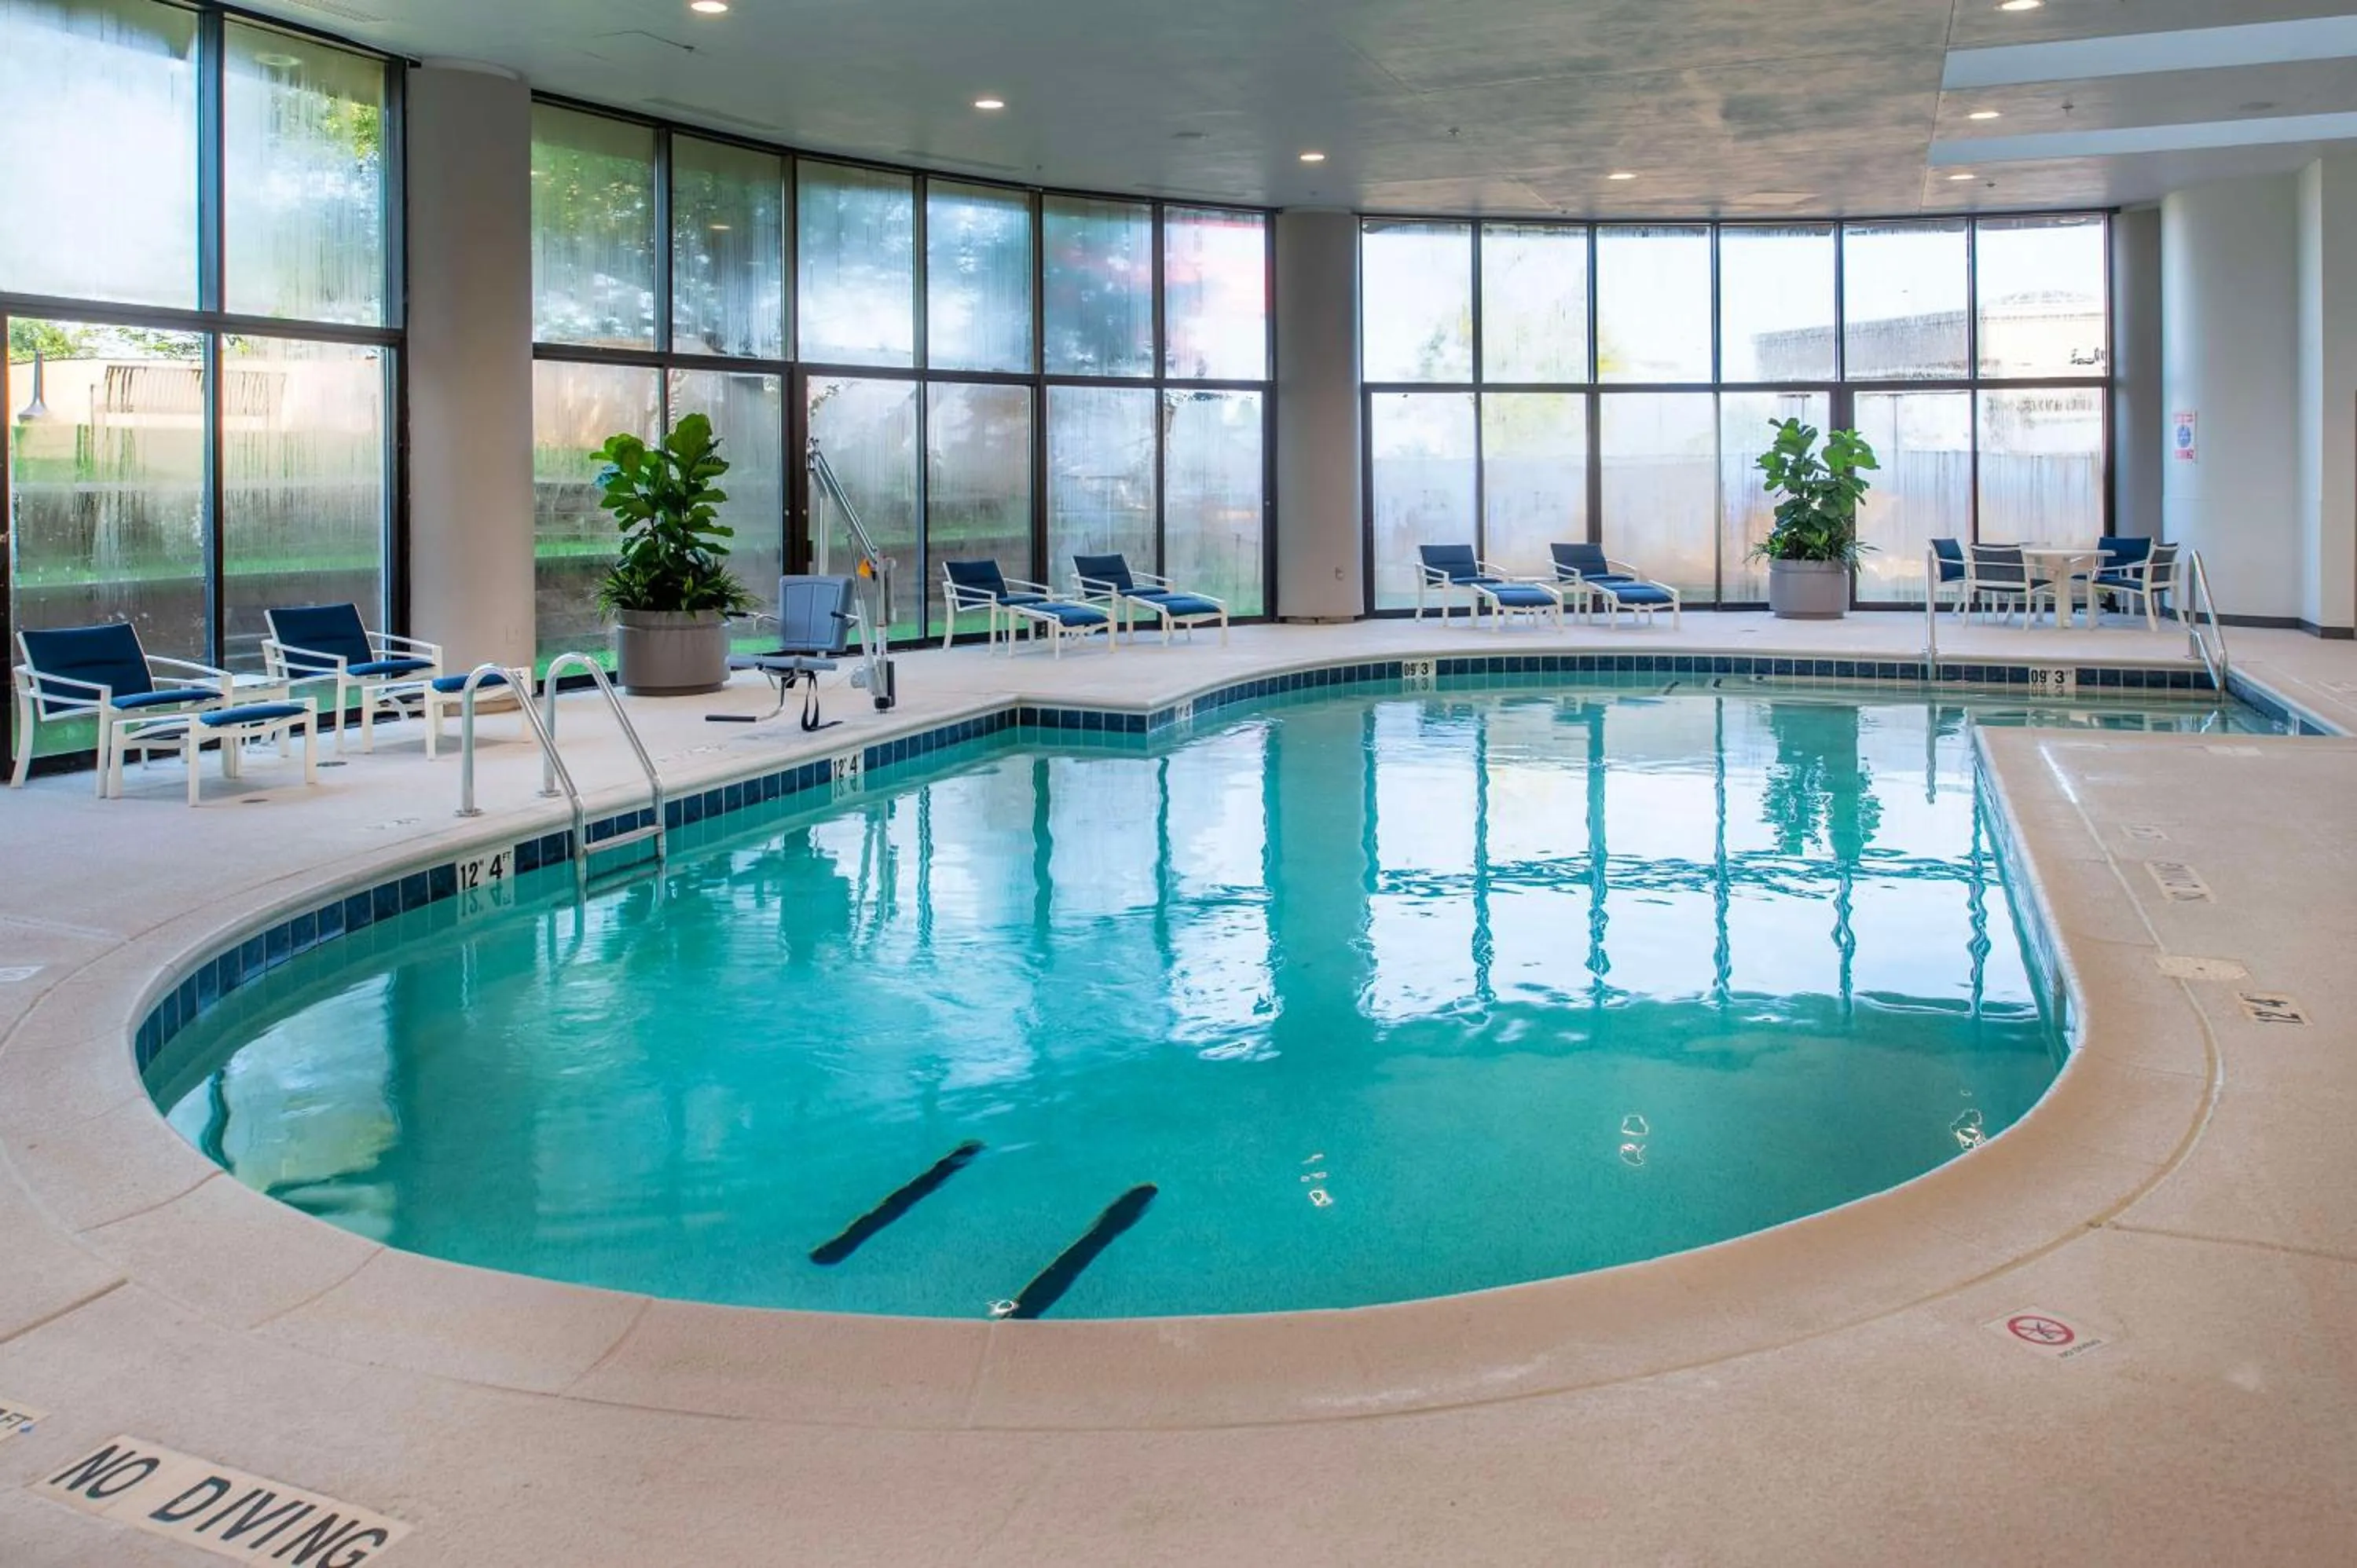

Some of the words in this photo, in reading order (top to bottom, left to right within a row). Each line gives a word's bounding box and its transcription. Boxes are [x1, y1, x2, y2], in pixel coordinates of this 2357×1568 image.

[1421, 662, 1428, 676] 3
[2055, 670, 2065, 684] 3
[849, 754, 857, 774] 4
[489, 854, 503, 880] 4
[50, 1445, 160, 1499] NO
[148, 1475, 388, 1568] DIVING
